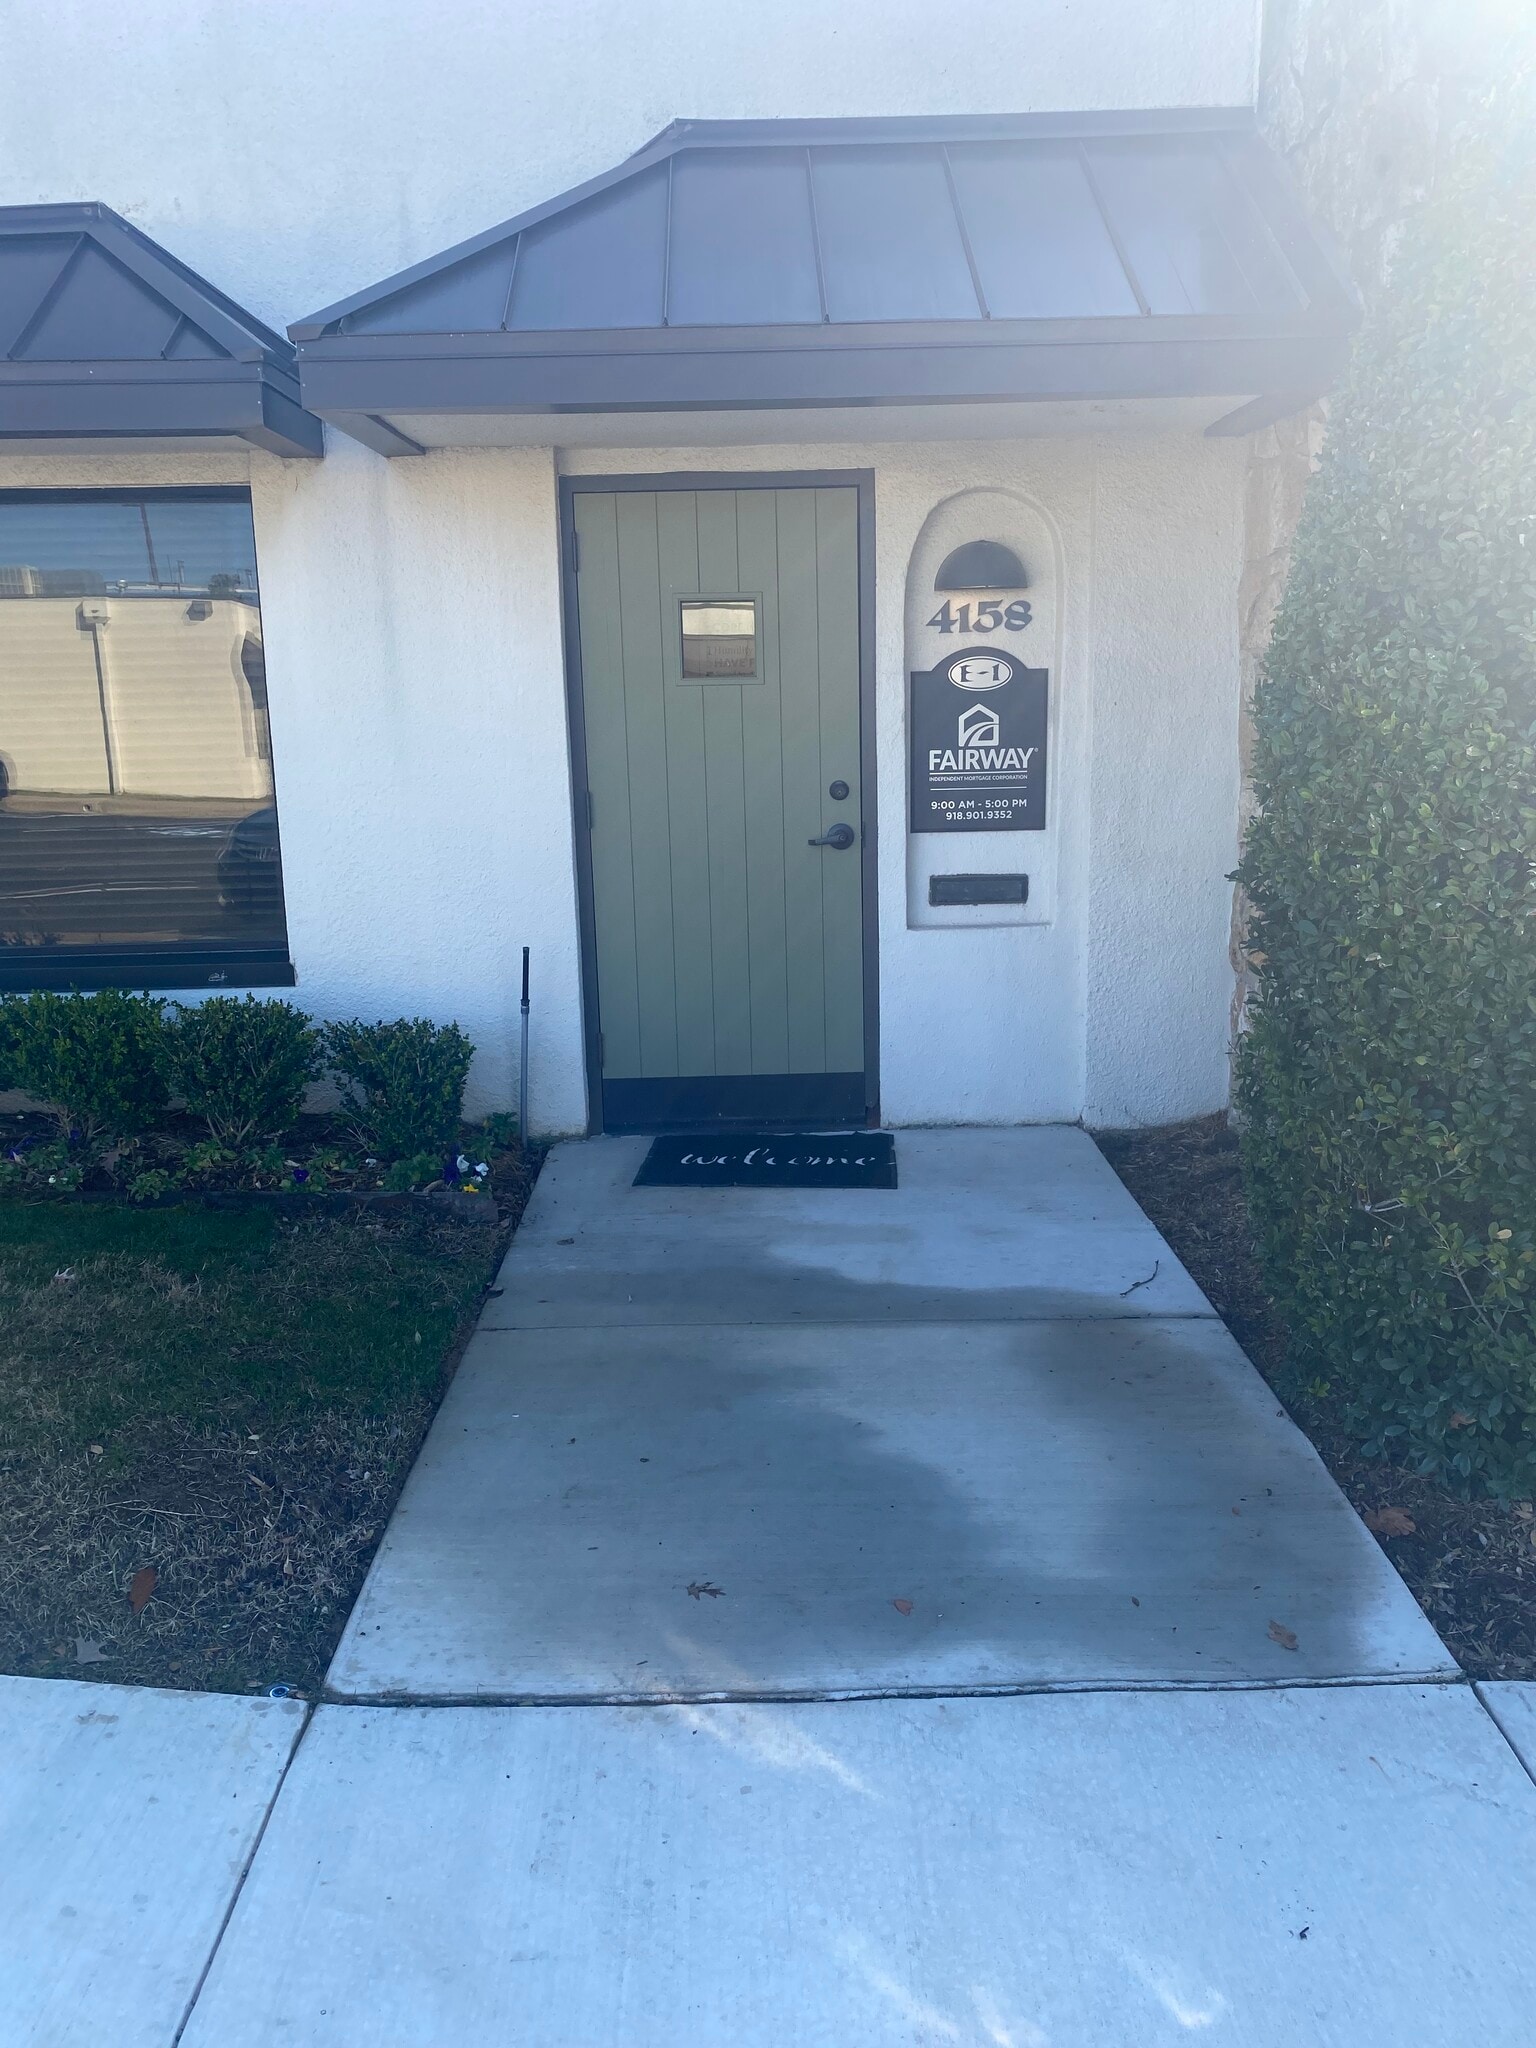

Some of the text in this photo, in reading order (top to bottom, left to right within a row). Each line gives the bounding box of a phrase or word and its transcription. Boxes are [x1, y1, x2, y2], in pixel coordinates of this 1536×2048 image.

[925, 599, 1033, 634] 4158
[929, 747, 1034, 771] FAIRWAY
[931, 801, 955, 810] 9:00
[958, 800, 975, 809] AM
[985, 799, 1009, 808] 5:00
[1012, 799, 1027, 808] PM
[945, 810, 1013, 820] 918.901.9352
[680, 1148, 876, 1166] welcome
